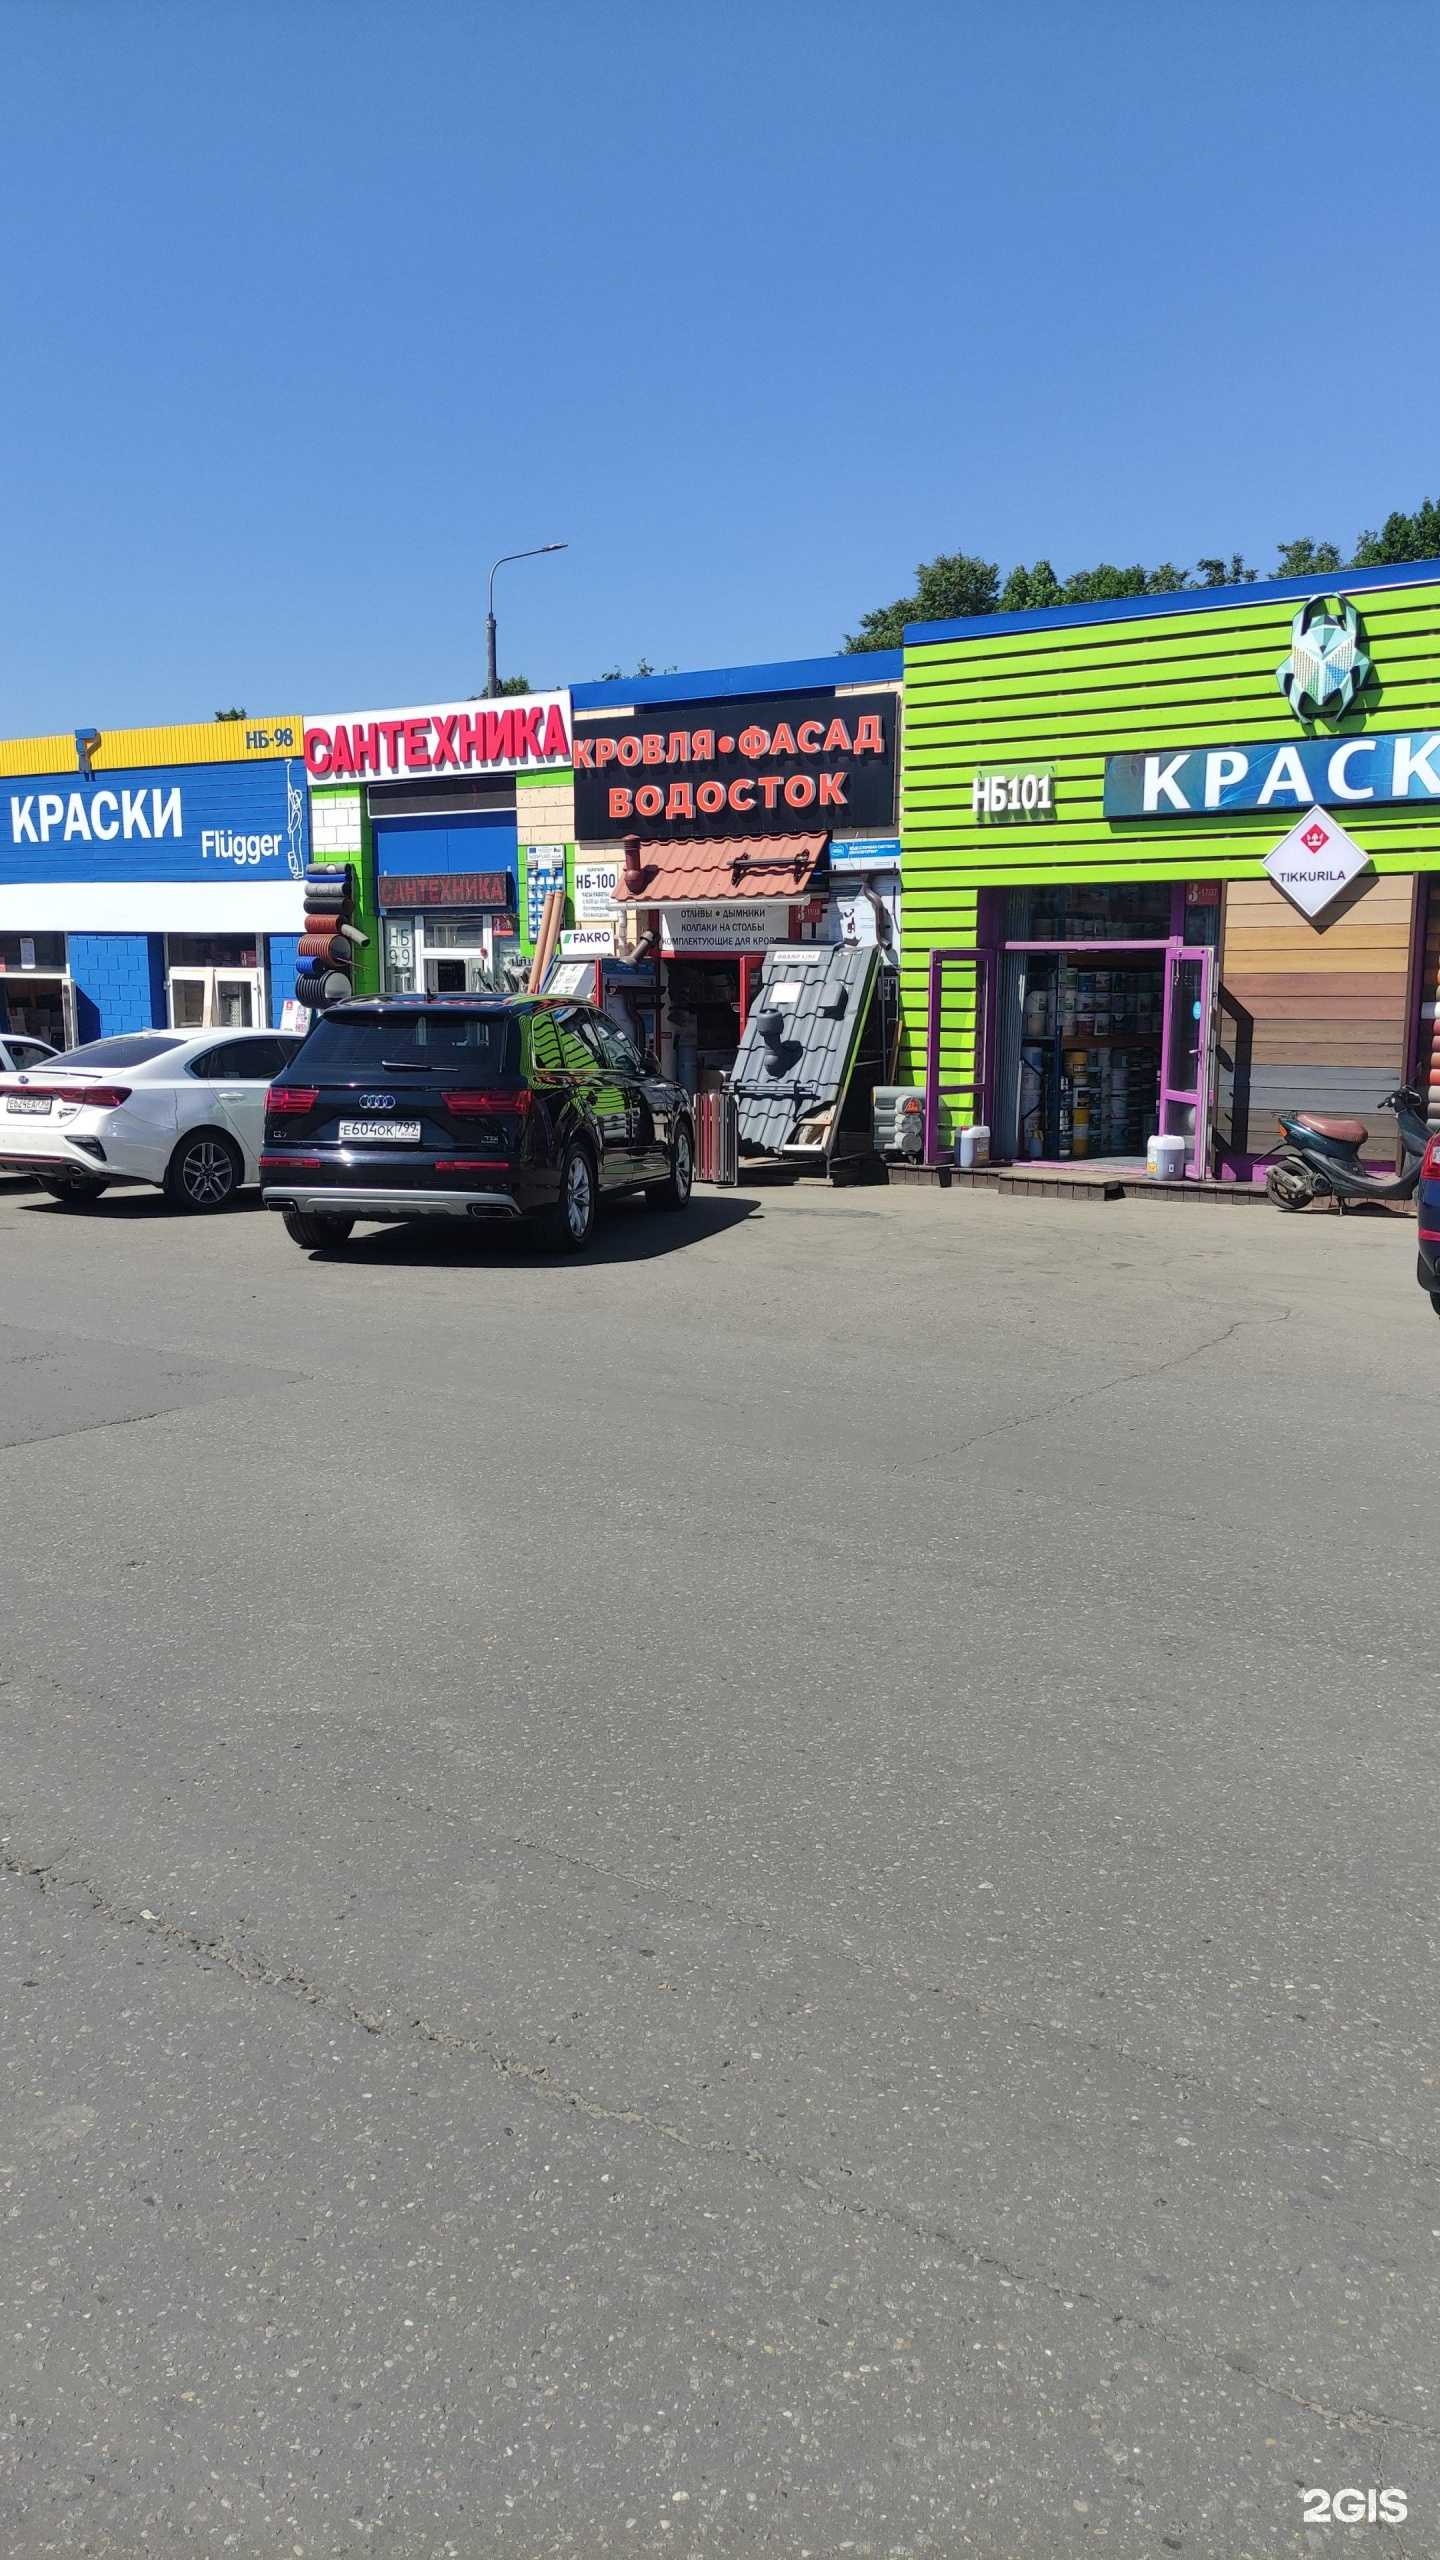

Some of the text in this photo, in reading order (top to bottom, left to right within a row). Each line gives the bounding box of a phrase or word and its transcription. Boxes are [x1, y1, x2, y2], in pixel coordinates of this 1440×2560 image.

[246, 727, 294, 750] НБ-98
[303, 704, 570, 775] САНТЕХНИКА
[573, 715, 885, 768] КРОВЛЯ ФАСАД
[1143, 733, 1440, 812] КРАСК
[608, 772, 849, 820] ВОДОСТОК
[972, 773, 1053, 812] НБ101
[10, 787, 183, 844] КРАСКИ
[201, 830, 283, 865] Flügger
[576, 873, 616, 889] НБ-100
[1279, 870, 1347, 882] TIKKURILA
[380, 877, 503, 903] САНТЕХНИКА
[680, 909, 766, 918] ОТЛИВЫ ДЫМНИКИ
[573, 932, 611, 943] FAKRO
[681, 922, 765, 932] КОЛПАКИ НА СТОЛБЫ
[662, 936, 776, 946] КОМПЛЕКТУЮЩИЕ ДЛЯ КРОВ
